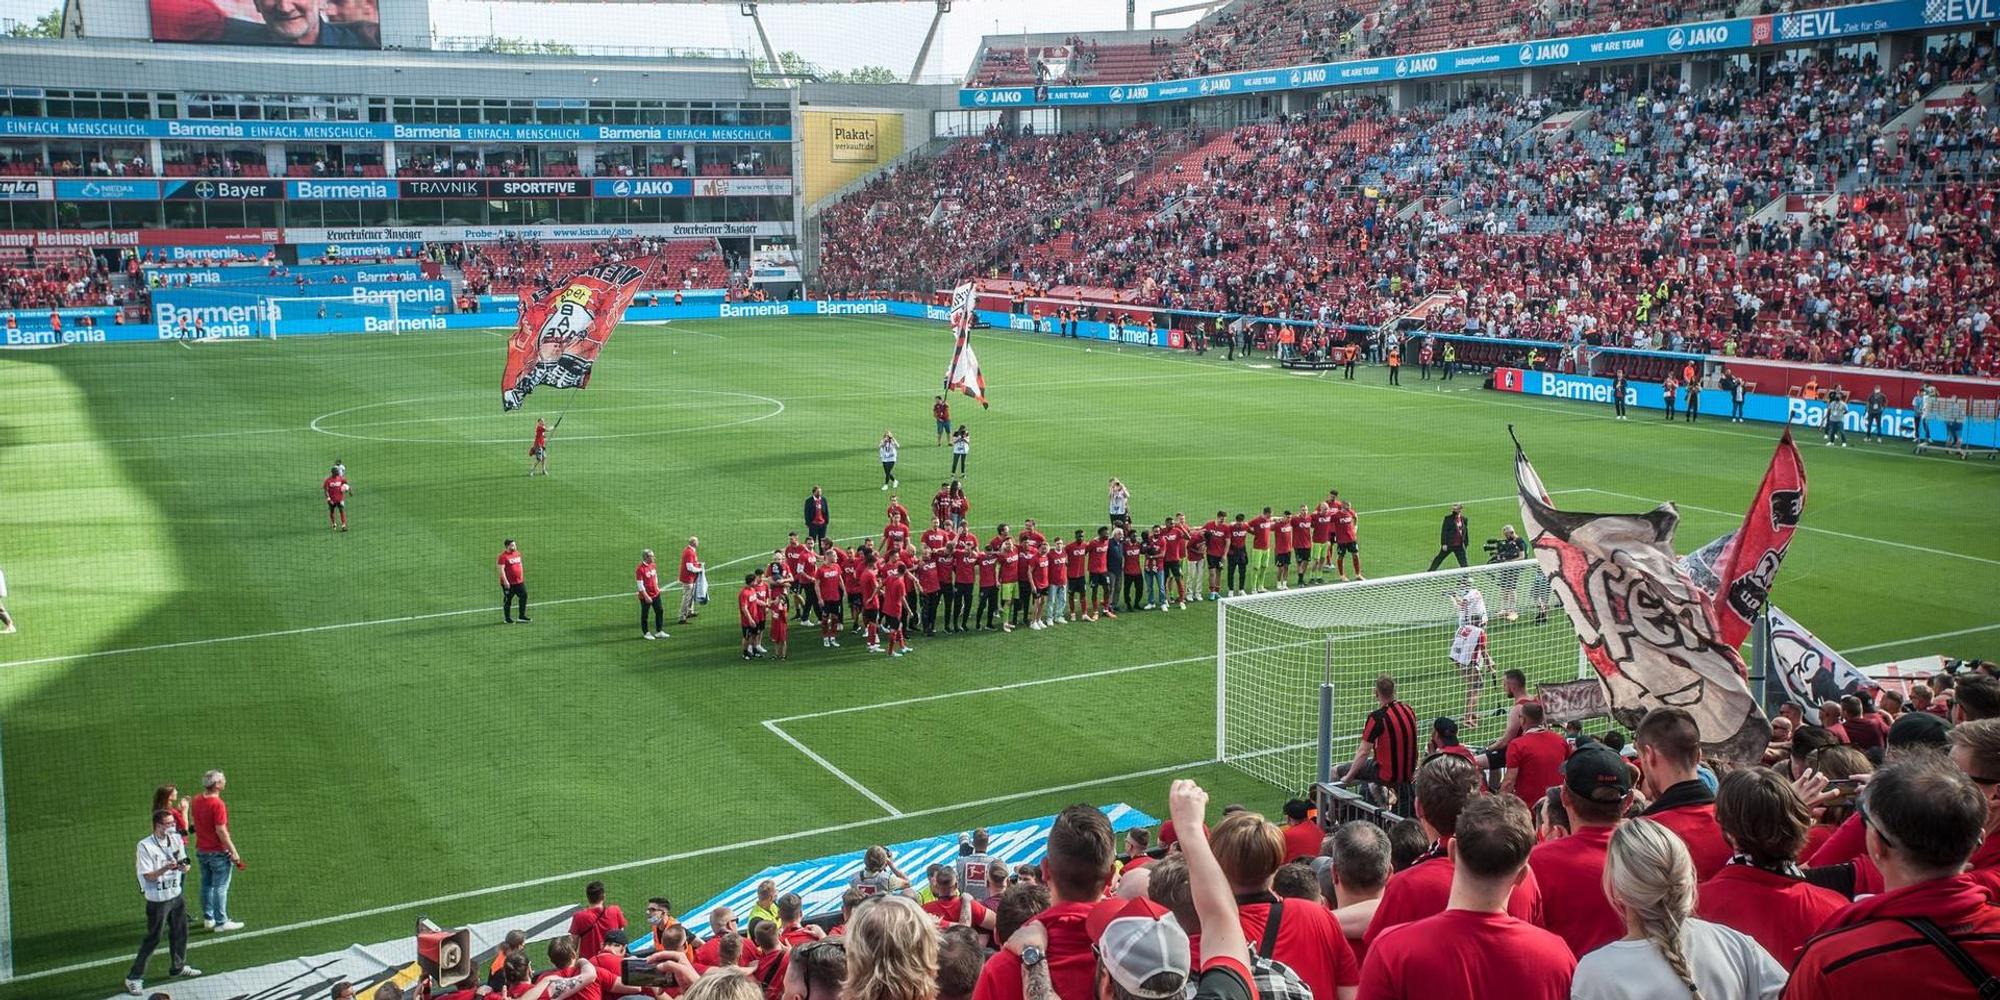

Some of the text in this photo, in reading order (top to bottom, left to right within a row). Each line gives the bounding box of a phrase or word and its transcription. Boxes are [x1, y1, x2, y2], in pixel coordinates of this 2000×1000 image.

[1800, 12, 1841, 37] EVL
[1688, 26, 1728, 45] JAKO
[1535, 43, 1569, 60] JAKO
[1591, 39, 1644, 52] WE ARE TEAM
[1409, 58, 1437, 73] JAKO
[1302, 69, 1326, 83] JAKO
[1210, 79, 1231, 91] JAKO
[991, 91, 1021, 103] JAKO
[1126, 87, 1149, 100] JAKO
[168, 121, 377, 138] Barmenia EINFACH. MENSCHLICH.
[394, 124, 461, 138] Barmenia
[468, 128, 513, 139] EINFACH.
[599, 126, 774, 139] Barmenia EINFACH. MENSCHLICH.
[835, 128, 874, 140] Plakat-
[219, 182, 266, 200] Bayer
[298, 181, 387, 198] Barmenia
[504, 182, 576, 194] SPORTFIVE
[634, 181, 673, 195] JAKO
[38, 231, 109, 246] Heimspiel
[553, 228, 633, 237] www.ksta.de/abo
[174, 246, 239, 259] Barmenia
[353, 284, 445, 304] Barmenia
[156, 300, 282, 324] Barmenia
[720, 302, 788, 317] Barmenia
[817, 300, 887, 314] Barmenia
[365, 315, 447, 332] Barmenia
